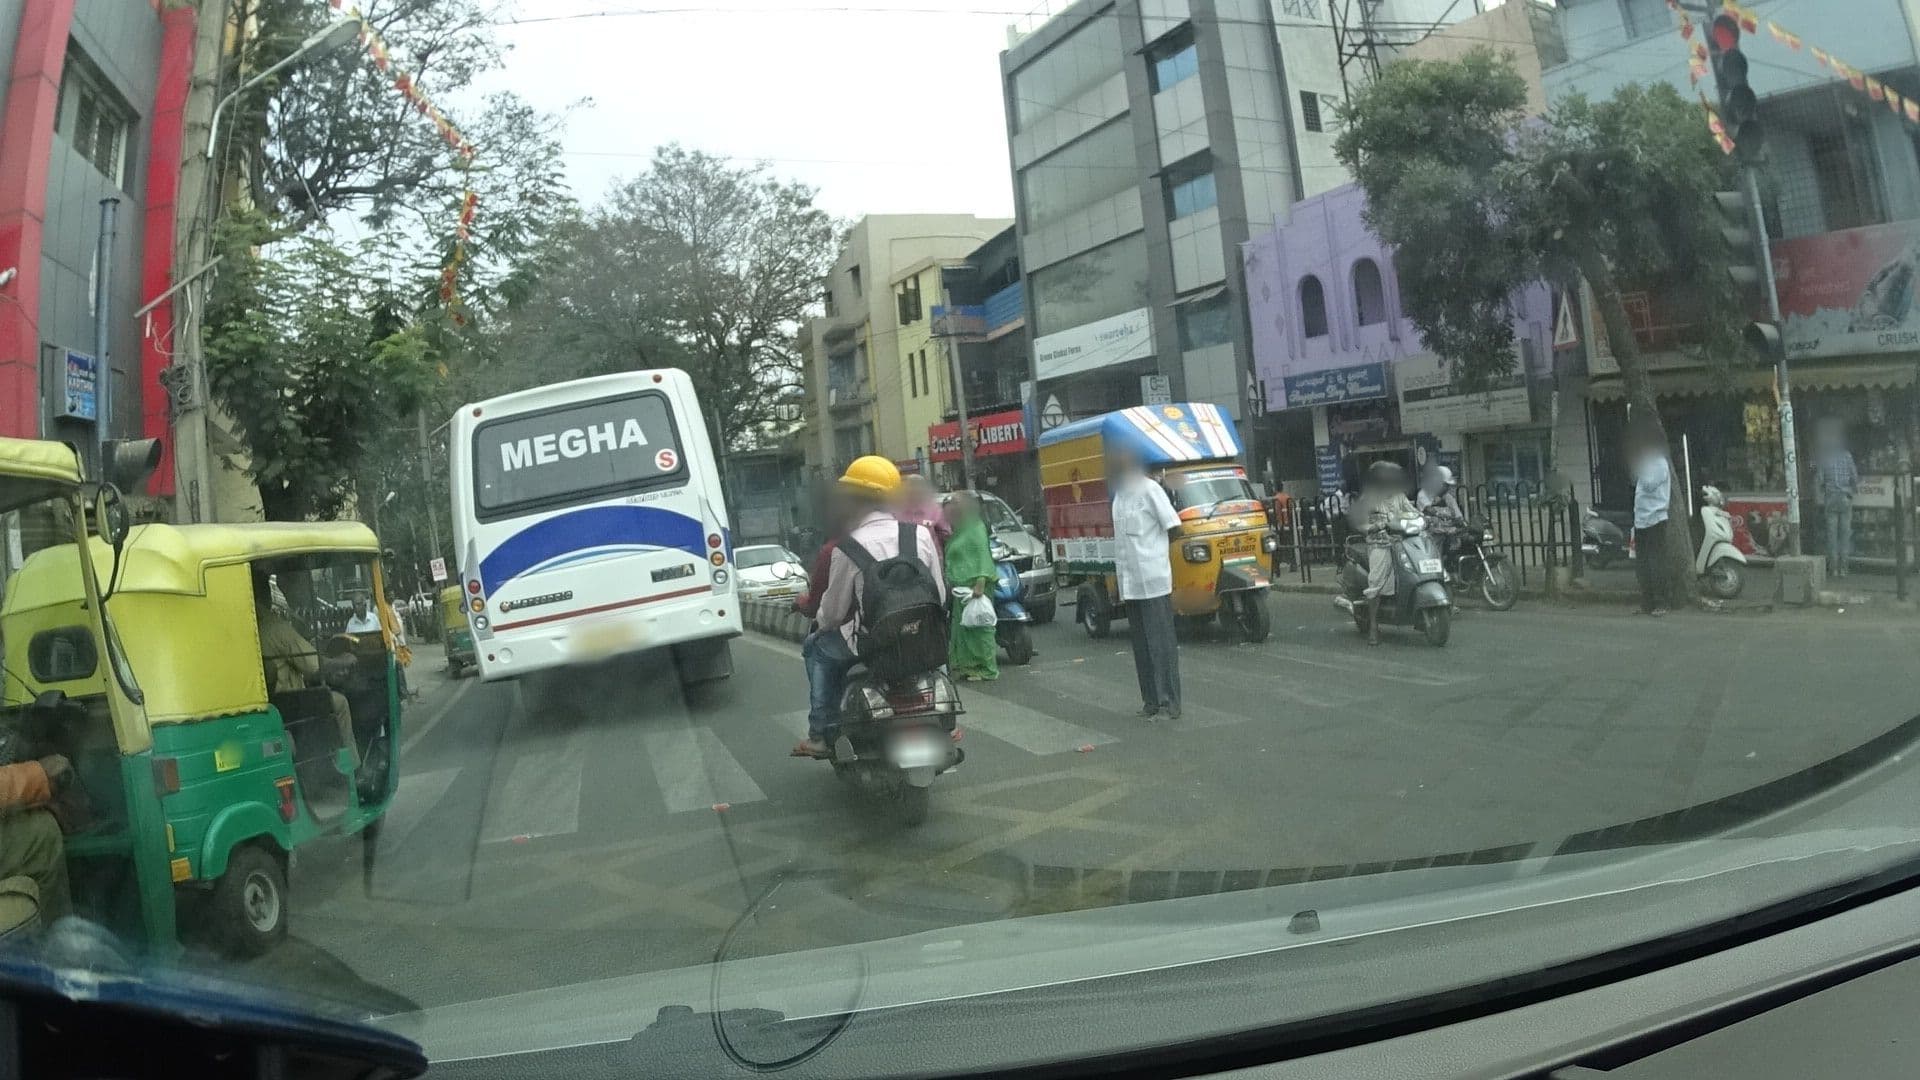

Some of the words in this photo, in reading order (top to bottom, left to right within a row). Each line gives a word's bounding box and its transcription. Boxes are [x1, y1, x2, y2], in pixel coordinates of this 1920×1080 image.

[500, 418, 648, 472] MEGHA
[980, 422, 1027, 445] LIBERTY
[659, 452, 675, 468] S
